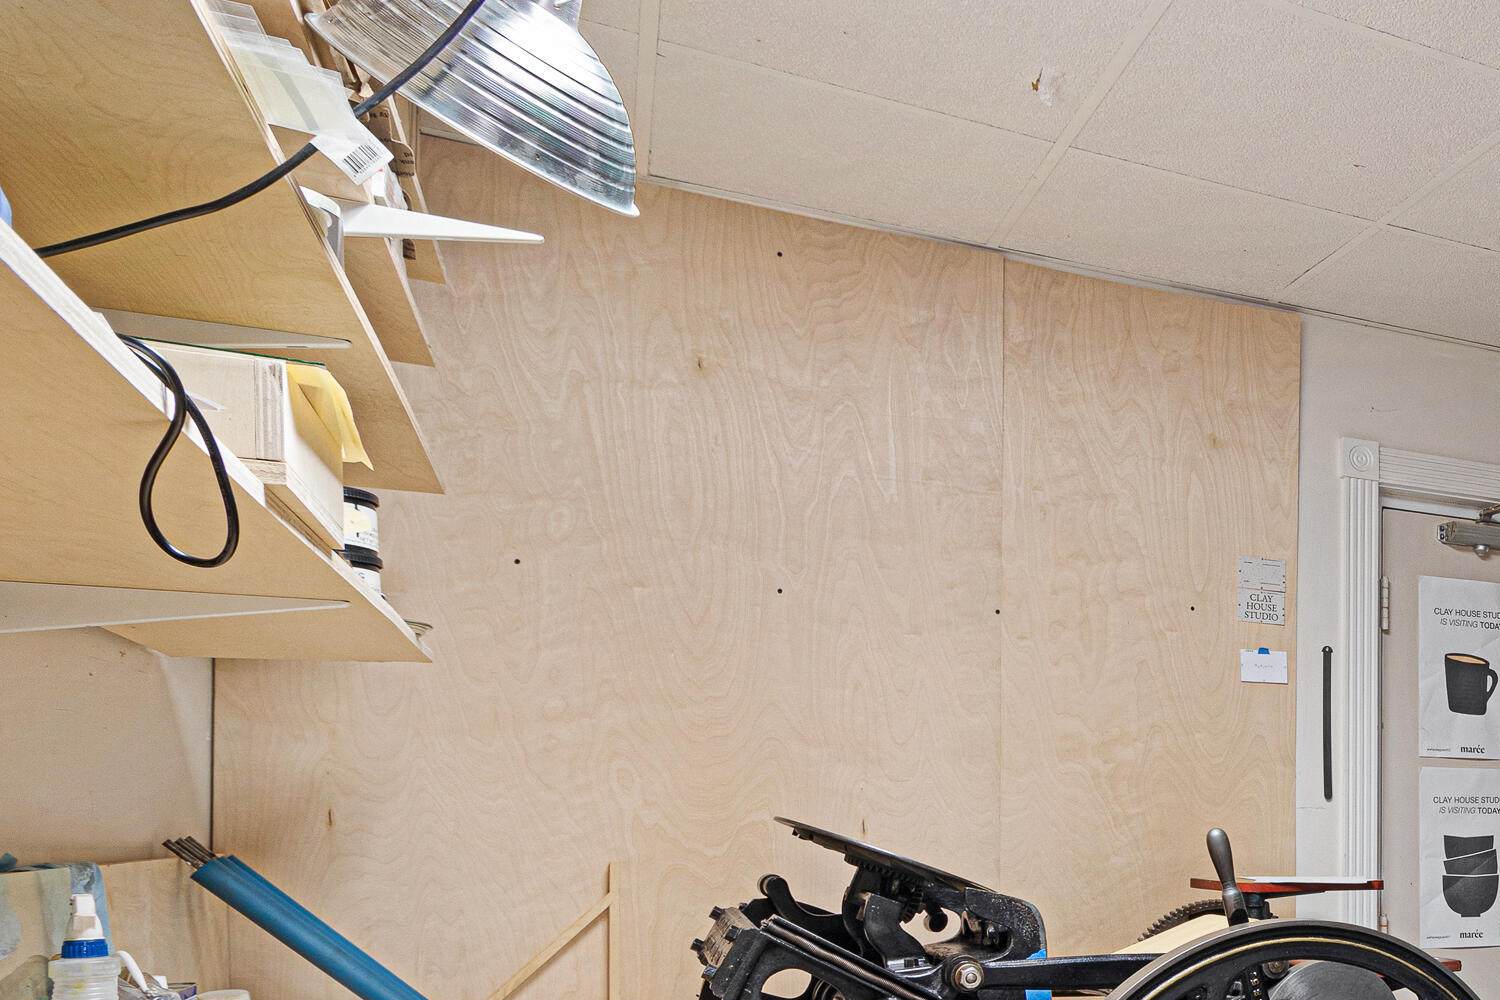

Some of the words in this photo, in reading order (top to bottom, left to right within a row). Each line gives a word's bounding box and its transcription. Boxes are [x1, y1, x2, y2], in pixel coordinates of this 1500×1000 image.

[1249, 593, 1274, 603] CLAY
[1246, 602, 1278, 612] HOUSE
[1244, 610, 1279, 621] STUDIO
[1433, 607, 1453, 616] CLAY
[1455, 609, 1481, 618] HOUSE
[1440, 618, 1447, 626] IS
[1449, 619, 1478, 629] VISITING
[1432, 796, 1453, 804] CLAY
[1454, 796, 1479, 804] HOUSE
[1438, 806, 1446, 814] IS
[1448, 806, 1476, 815] VISITING
